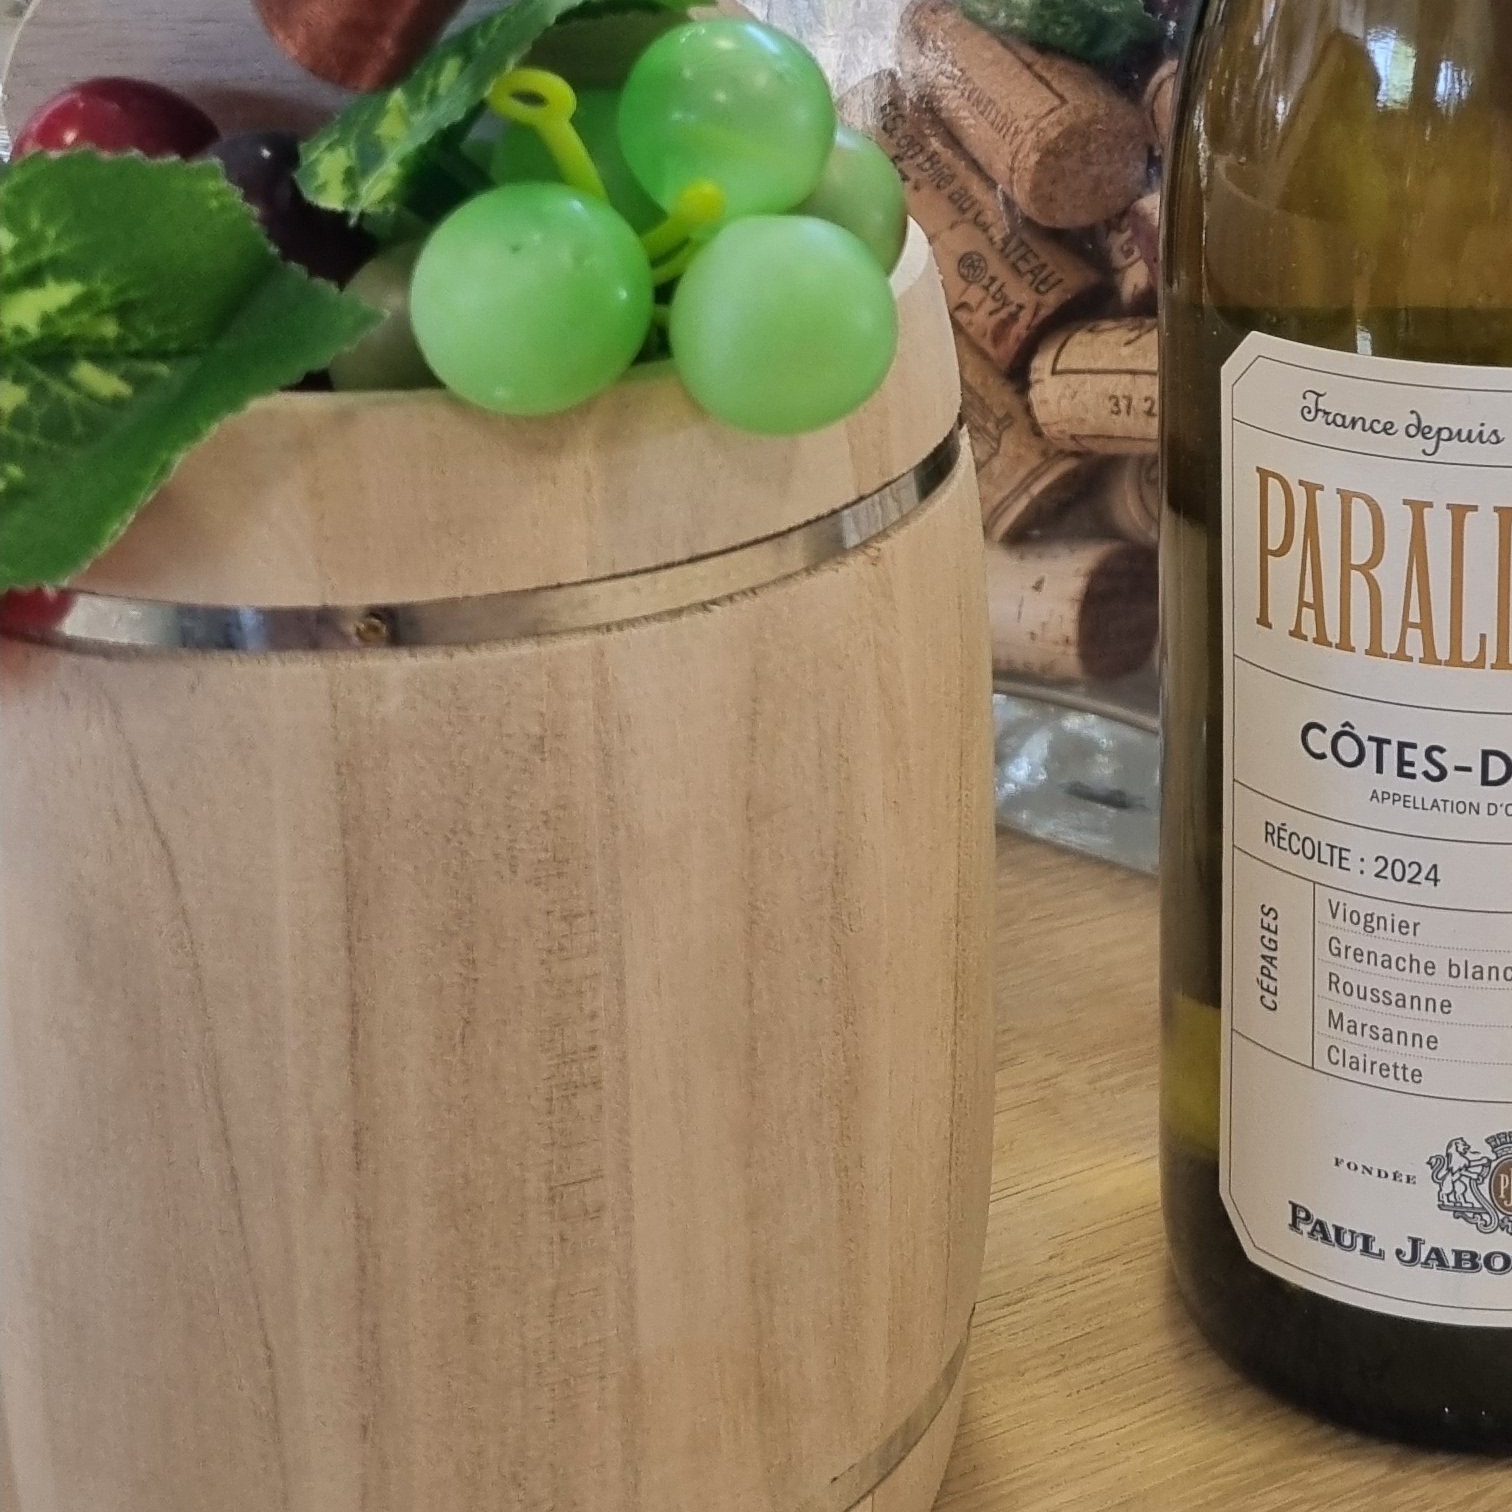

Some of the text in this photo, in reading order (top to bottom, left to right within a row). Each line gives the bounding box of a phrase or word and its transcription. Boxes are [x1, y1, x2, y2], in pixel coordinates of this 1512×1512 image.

[1107, 394, 1134, 417] 37
[1300, 389, 1398, 438] France
[1405, 409, 1505, 457] depuis
[1369, 789, 1481, 818] APPELLATION
[1263, 819, 1351, 873] RÉCOLTE
[1373, 855, 1442, 888] 2024
[1327, 899, 1421, 939] Viognier
[1260, 903, 1280, 1012] CÉPAGES
[1327, 937, 1440, 980] Grenache
[1327, 972, 1453, 1015] Roussanne
[1327, 1009, 1439, 1051] Marsanne
[1326, 1044, 1424, 1086] Clairette
[1334, 1156, 1418, 1186] FONDÉE
[1287, 1199, 1386, 1261] PAUL
